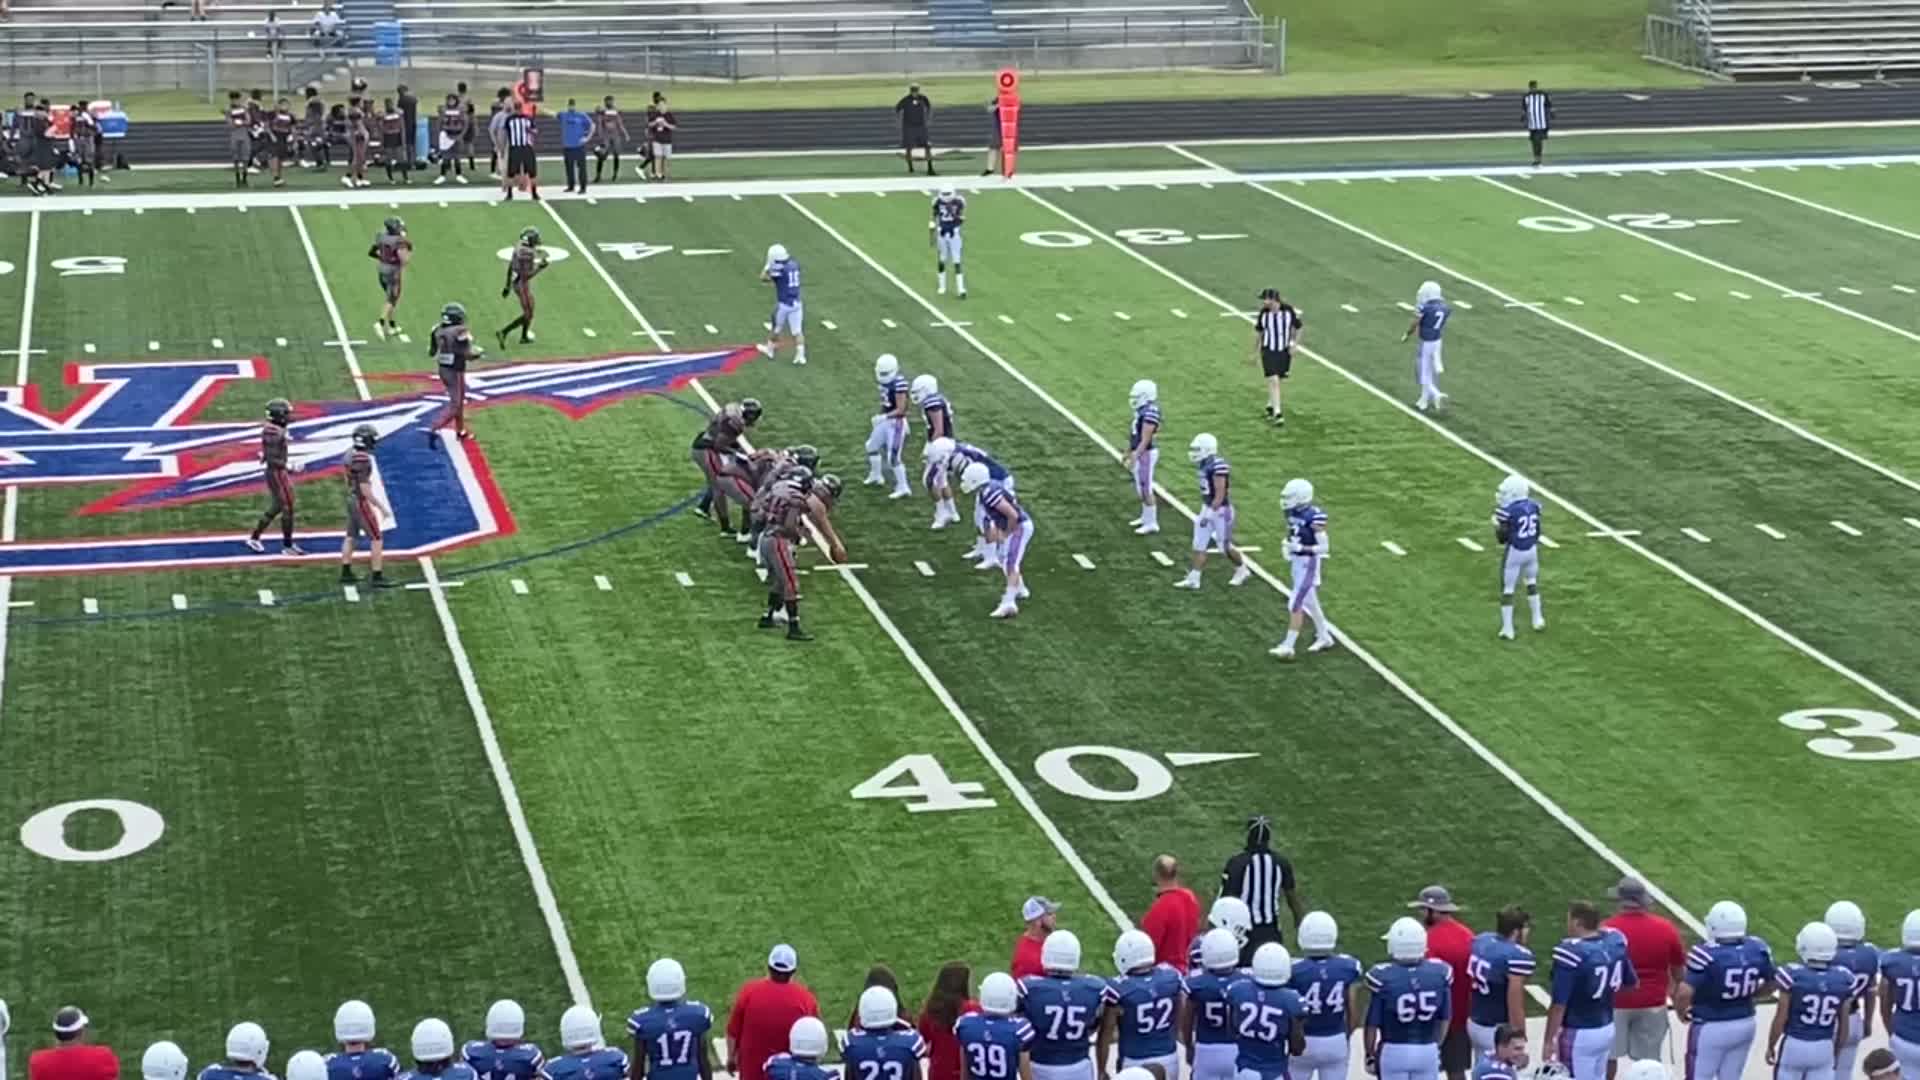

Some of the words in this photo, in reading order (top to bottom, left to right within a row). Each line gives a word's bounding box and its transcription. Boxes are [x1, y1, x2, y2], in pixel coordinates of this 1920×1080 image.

[1020, 228, 1192, 247] 30
[1517, 212, 1696, 232] 20
[1433, 311, 1444, 329] 7
[850, 745, 1174, 813] 40
[20, 798, 165, 861] 0
[1304, 981, 1345, 1014] 44
[1592, 960, 1623, 1000] 74
[1044, 1004, 1086, 1040] 75
[1137, 997, 1173, 1033] 52
[1239, 1001, 1283, 1041] 25
[1397, 991, 1437, 1023] 65
[1800, 994, 1840, 1026] 36
[656, 1030, 692, 1066] 17
[967, 1042, 1007, 1078] 39
